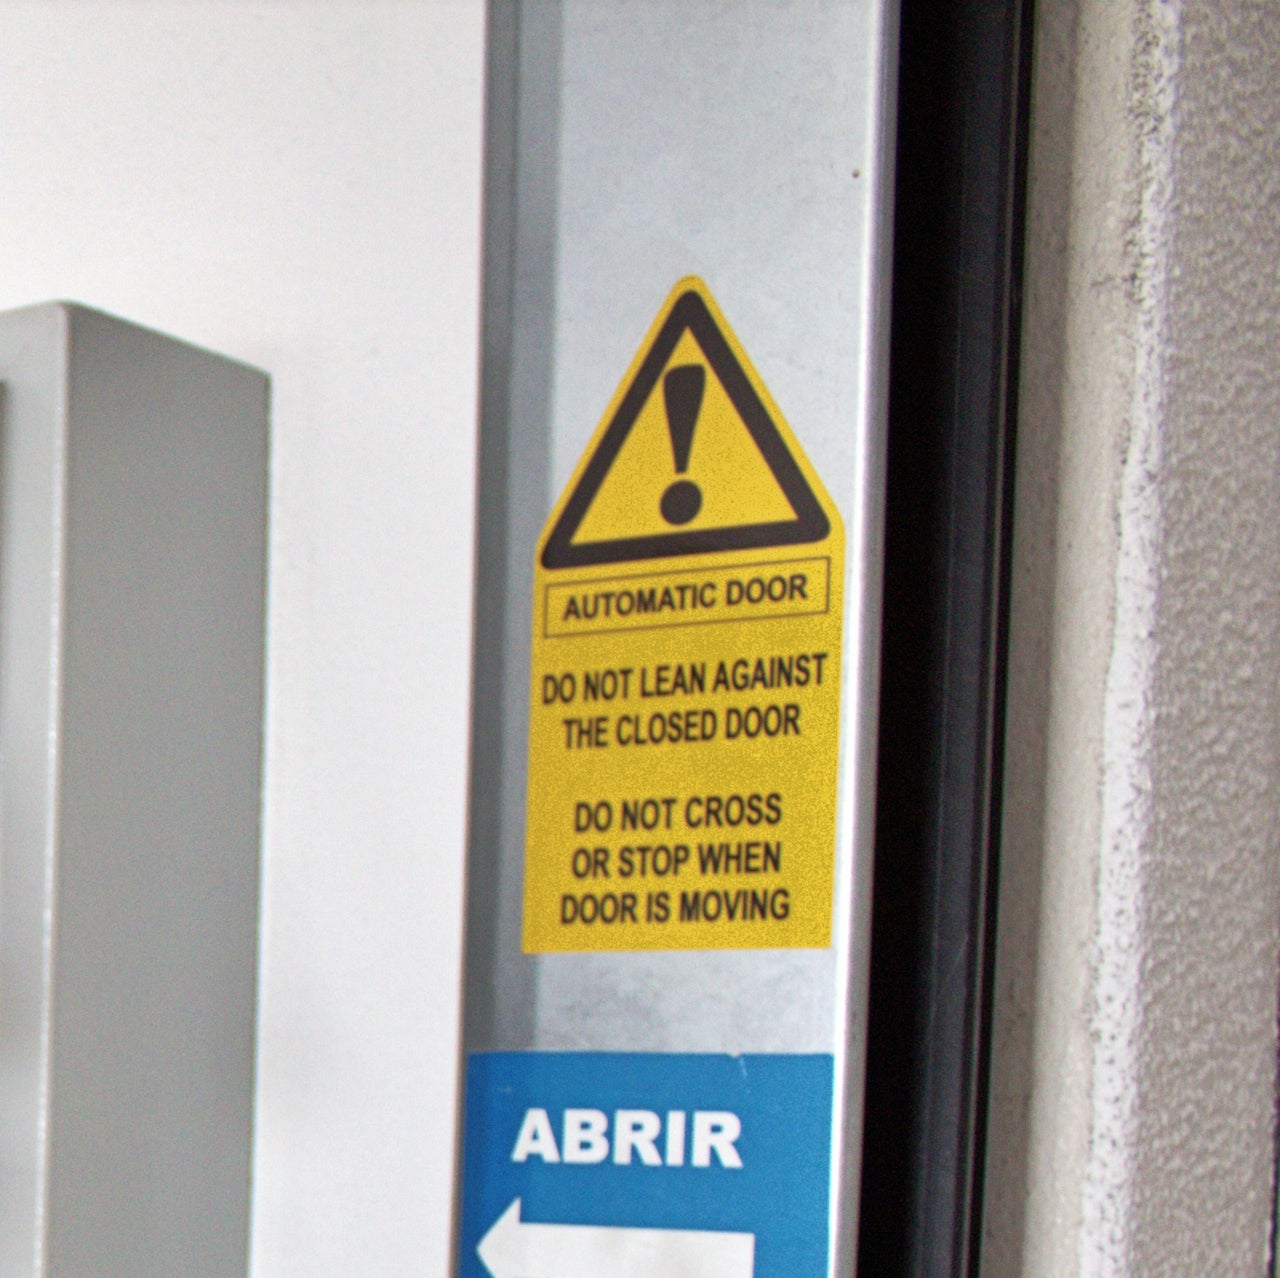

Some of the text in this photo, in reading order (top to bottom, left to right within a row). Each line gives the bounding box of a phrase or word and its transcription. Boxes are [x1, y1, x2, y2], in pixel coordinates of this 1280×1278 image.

[563, 573, 808, 621] AUTOMATIC DOOR
[542, 653, 829, 705] DO NOT LEAN AGAINST
[563, 703, 801, 749] THE CLOSED DOOR
[574, 793, 783, 834] DO NOT CROSS
[572, 841, 782, 880] OR STOP WHEN
[560, 887, 791, 925] DOOR IS MOVING
[511, 1107, 744, 1168] ABRIR
